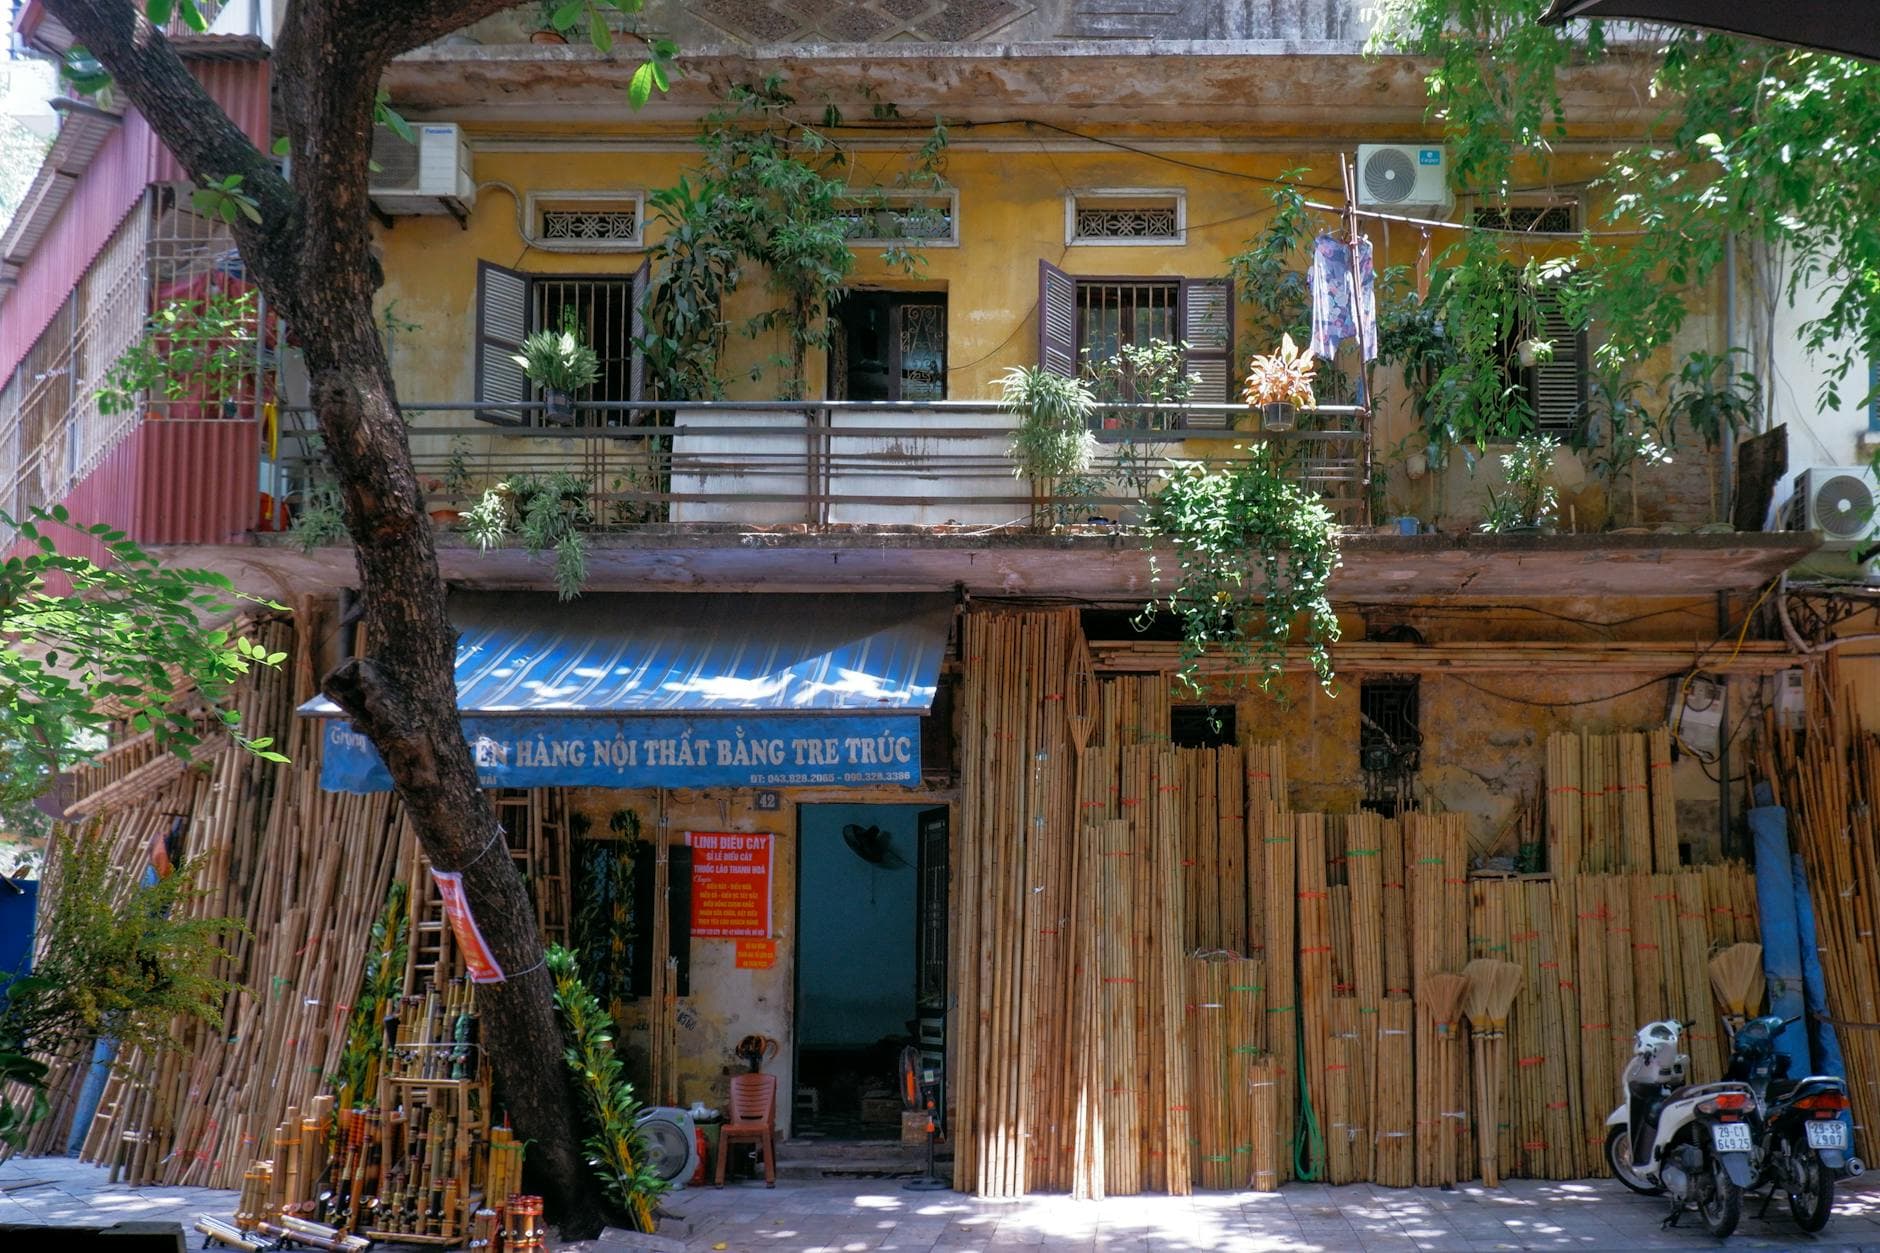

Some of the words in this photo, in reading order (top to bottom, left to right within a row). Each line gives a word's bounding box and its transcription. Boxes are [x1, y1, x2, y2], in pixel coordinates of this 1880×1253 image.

[515, 732, 587, 767] HÀNG
[592, 731, 638, 774] NỘI
[643, 727, 711, 767] THẤT
[716, 725, 786, 767] BẰNG
[791, 738, 840, 766] TRE
[845, 729, 912, 764] TRÚC
[759, 793, 776, 809] 42
